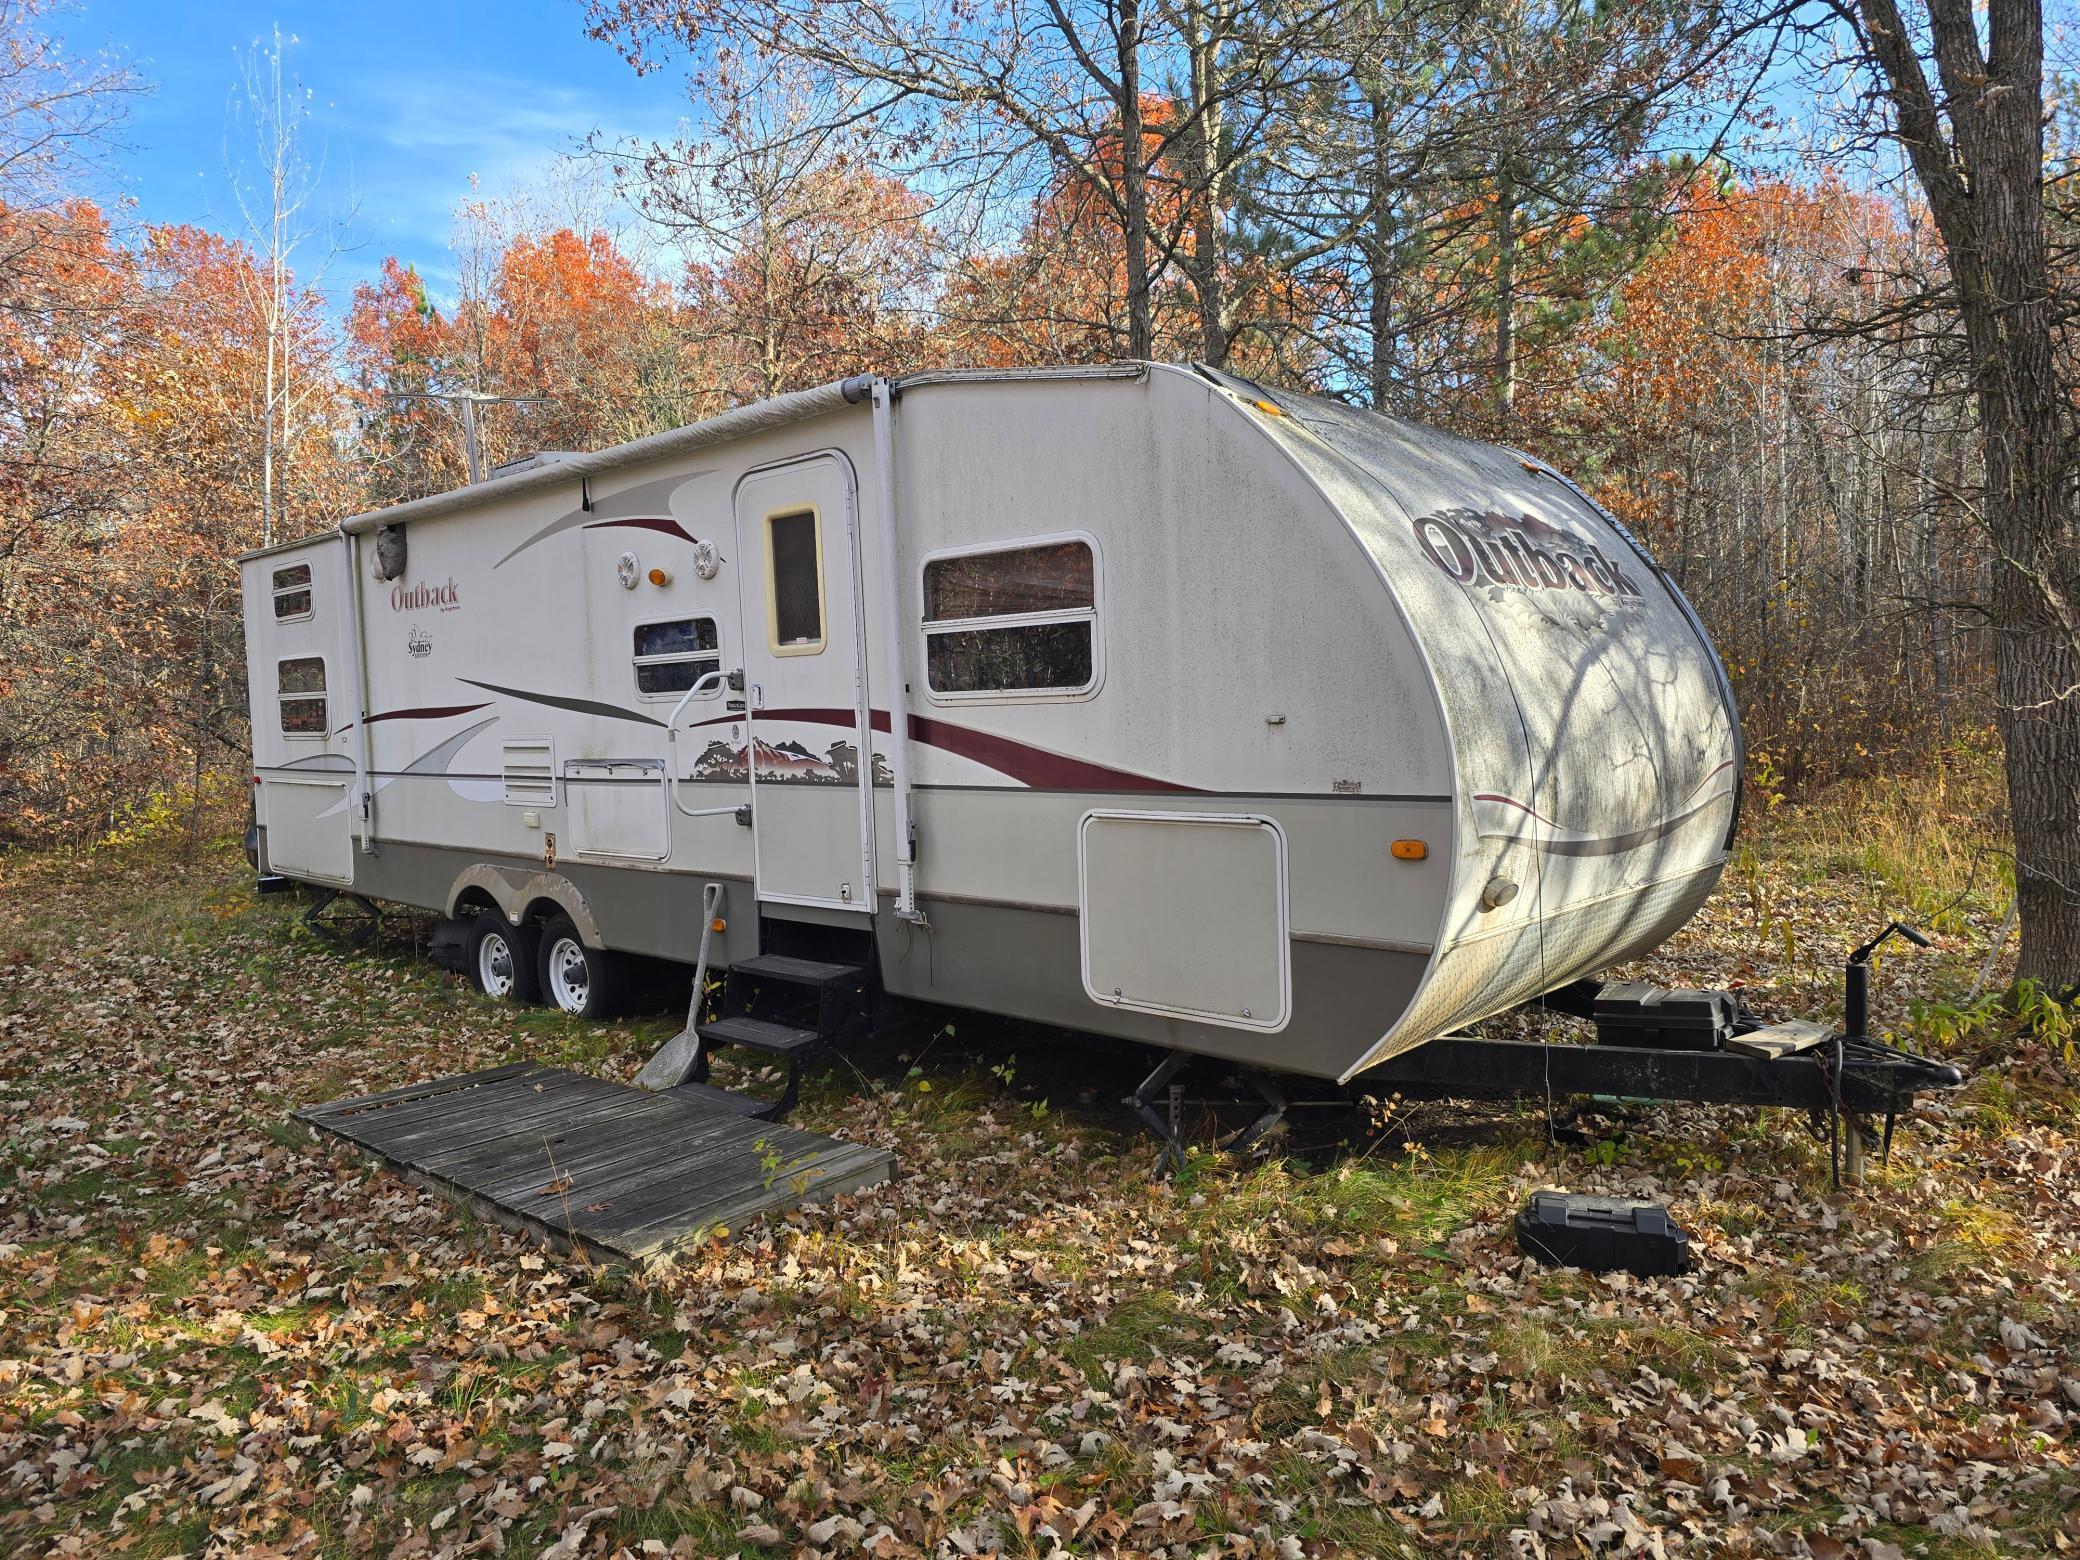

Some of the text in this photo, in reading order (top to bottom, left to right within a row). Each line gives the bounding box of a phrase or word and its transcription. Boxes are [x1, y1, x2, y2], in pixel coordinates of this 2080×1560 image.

[1413, 517, 1642, 597] Outback
[391, 577, 459, 612] Outback
[408, 641, 432, 655] Sydney
